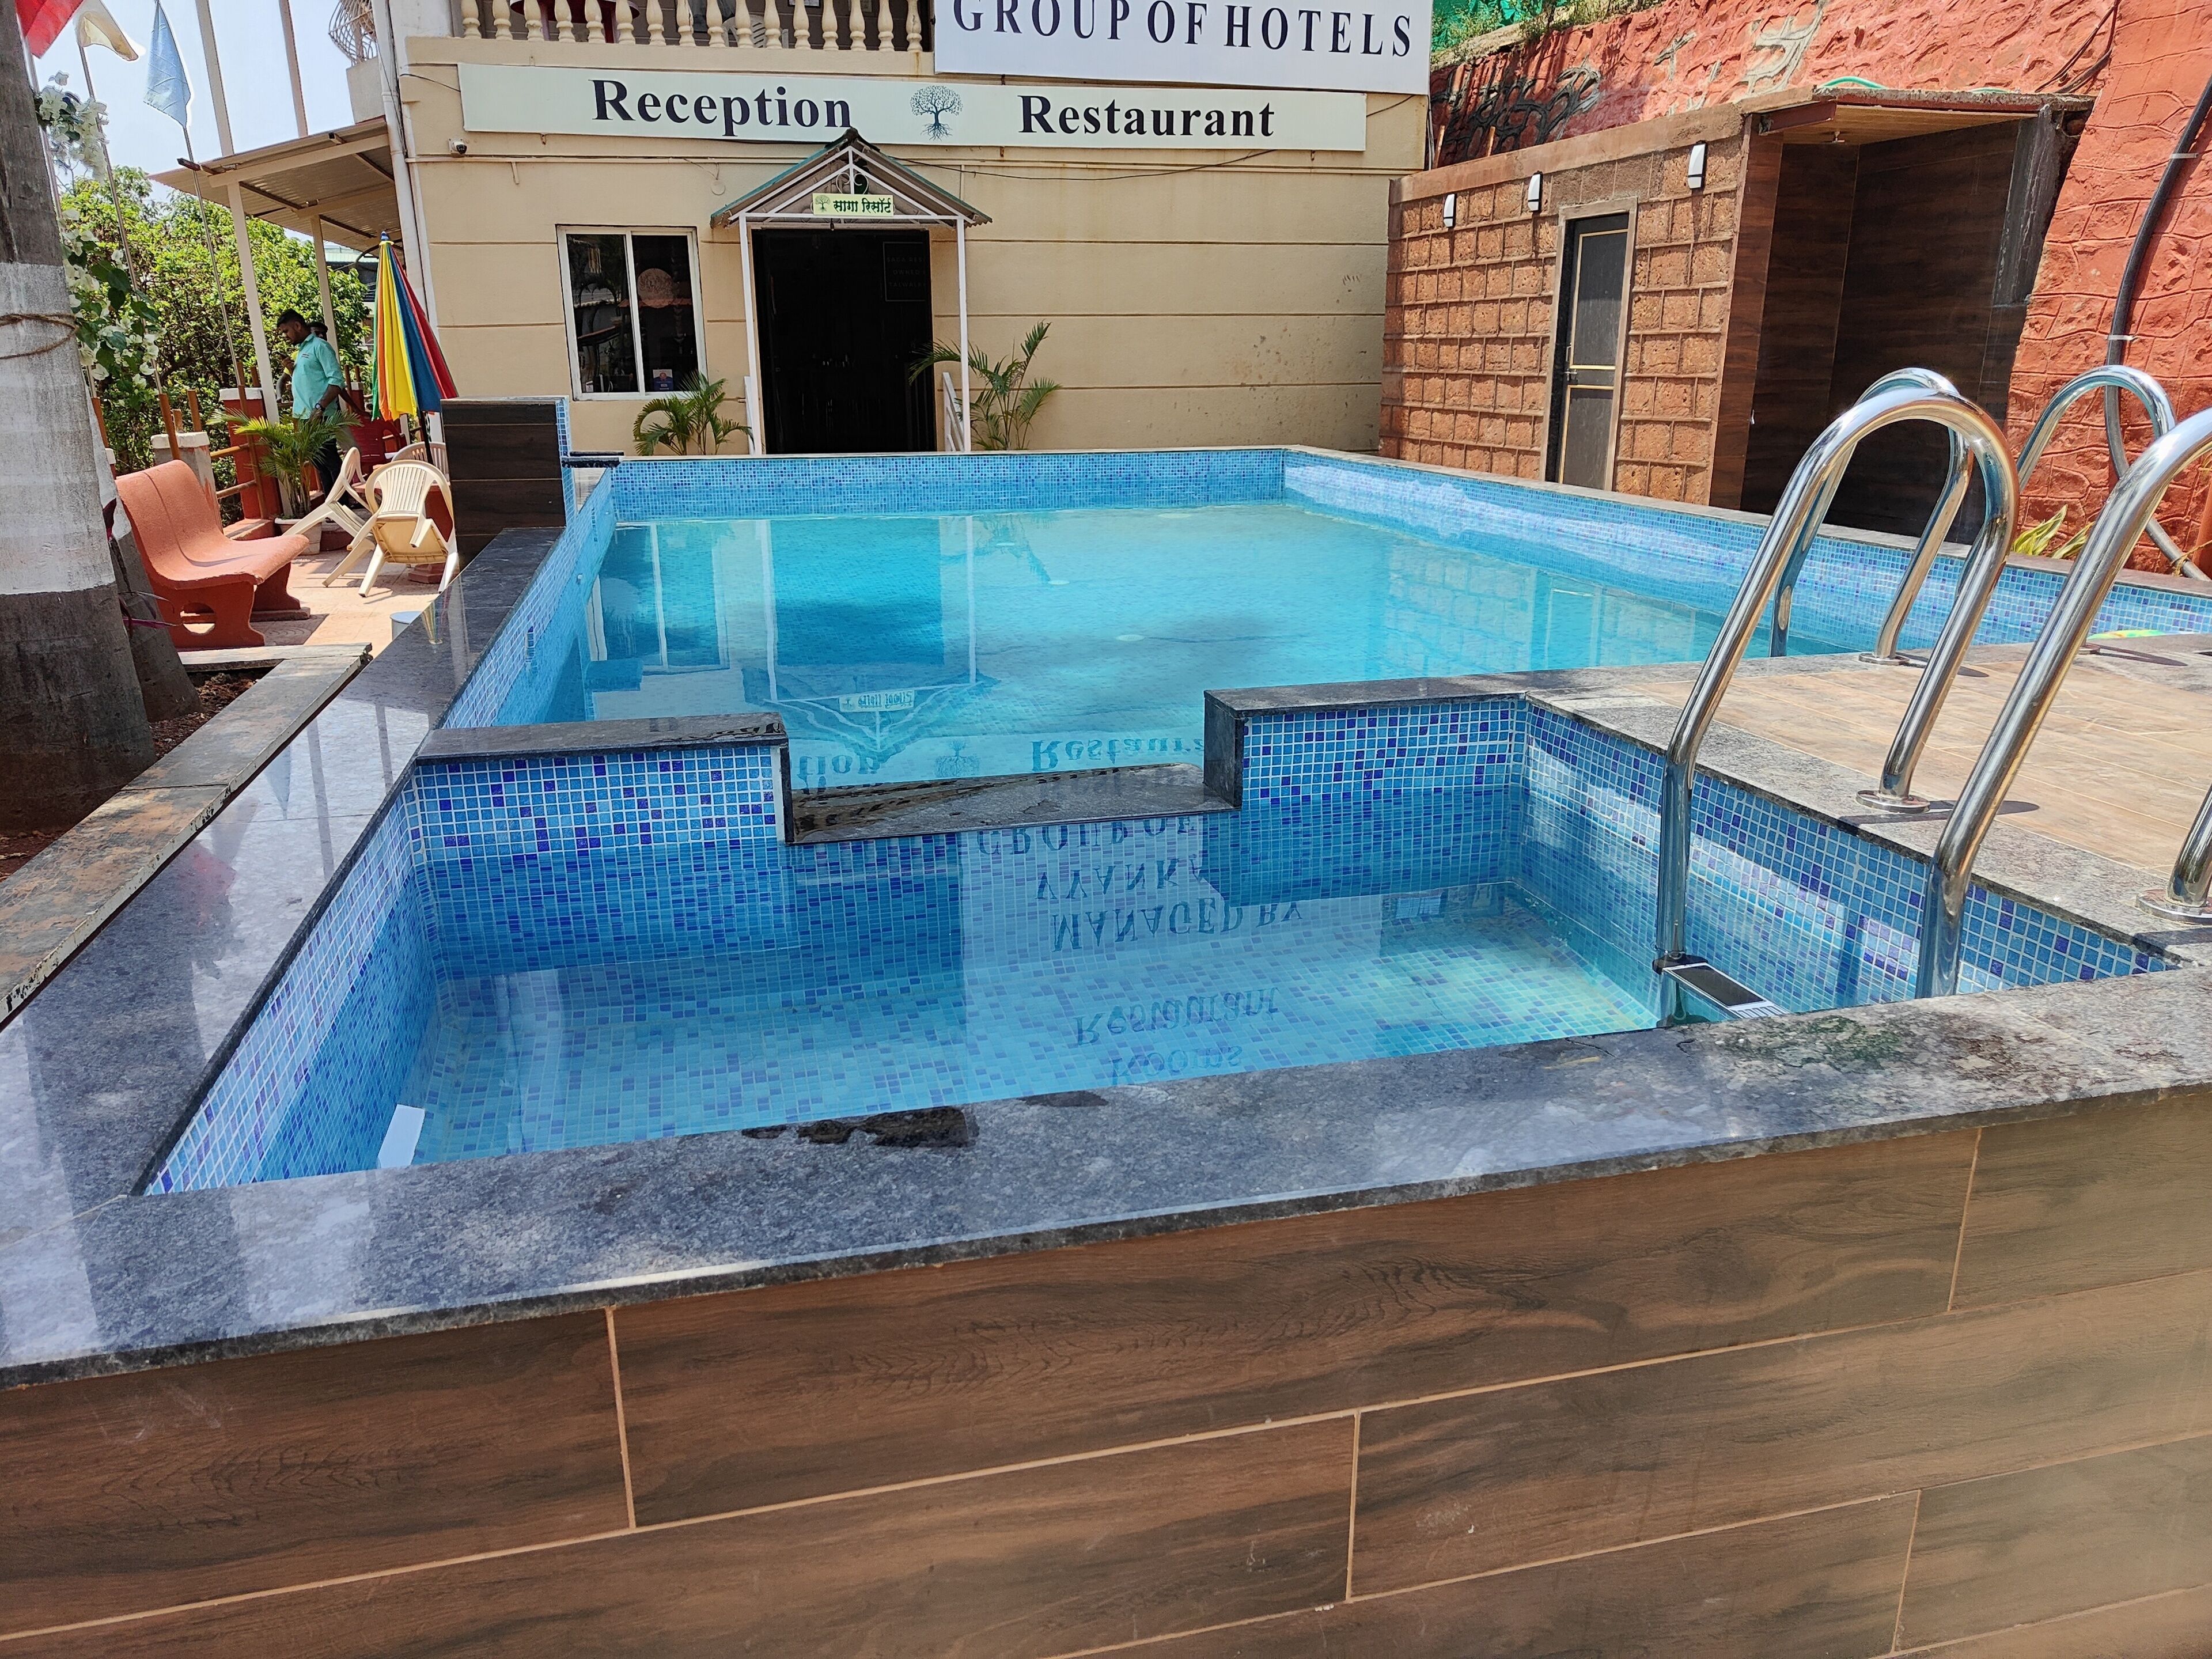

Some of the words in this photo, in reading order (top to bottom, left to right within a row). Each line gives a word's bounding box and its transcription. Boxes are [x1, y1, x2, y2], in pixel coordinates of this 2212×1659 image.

[953, 0, 1130, 40] GROUP
[1147, 0, 1207, 44] OF
[1224, 5, 1410, 56] HOTELS
[589, 79, 853, 137] Reception
[1018, 95, 1275, 138] Restaurant
[833, 199, 858, 213] सागा
[862, 197, 891, 214] रिसॉर्ट
